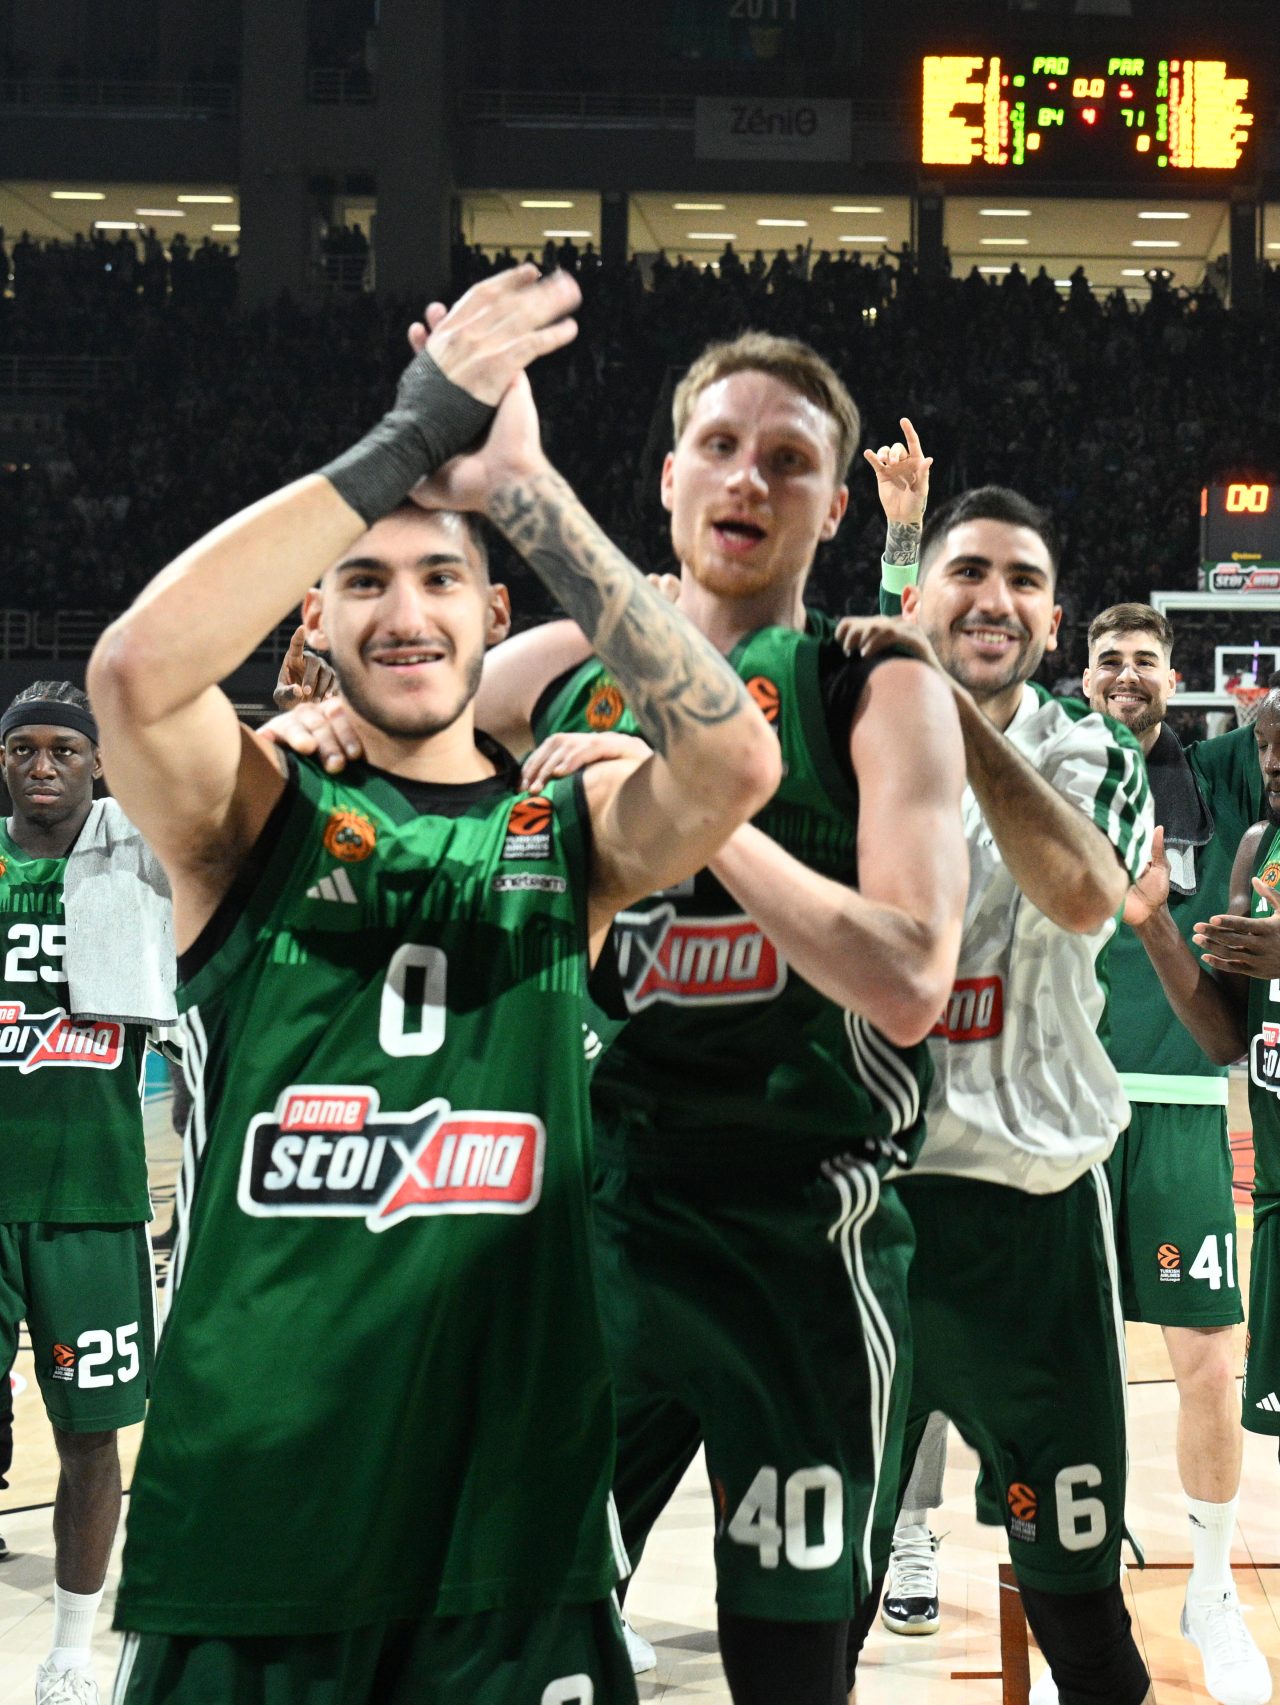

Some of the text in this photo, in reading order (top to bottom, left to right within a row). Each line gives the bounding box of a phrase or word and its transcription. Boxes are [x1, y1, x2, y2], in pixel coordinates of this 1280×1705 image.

[1108, 58, 1144, 75] PAR
[1121, 109, 1145, 127] 71
[4, 923, 68, 982] 25
[378, 943, 448, 1058] 0
[287, 1100, 362, 1128] pame
[1188, 1232, 1235, 1290] 41
[77, 1321, 140, 1389] 25
[727, 1465, 844, 1570] 40
[1055, 1463, 1107, 1552] 6
